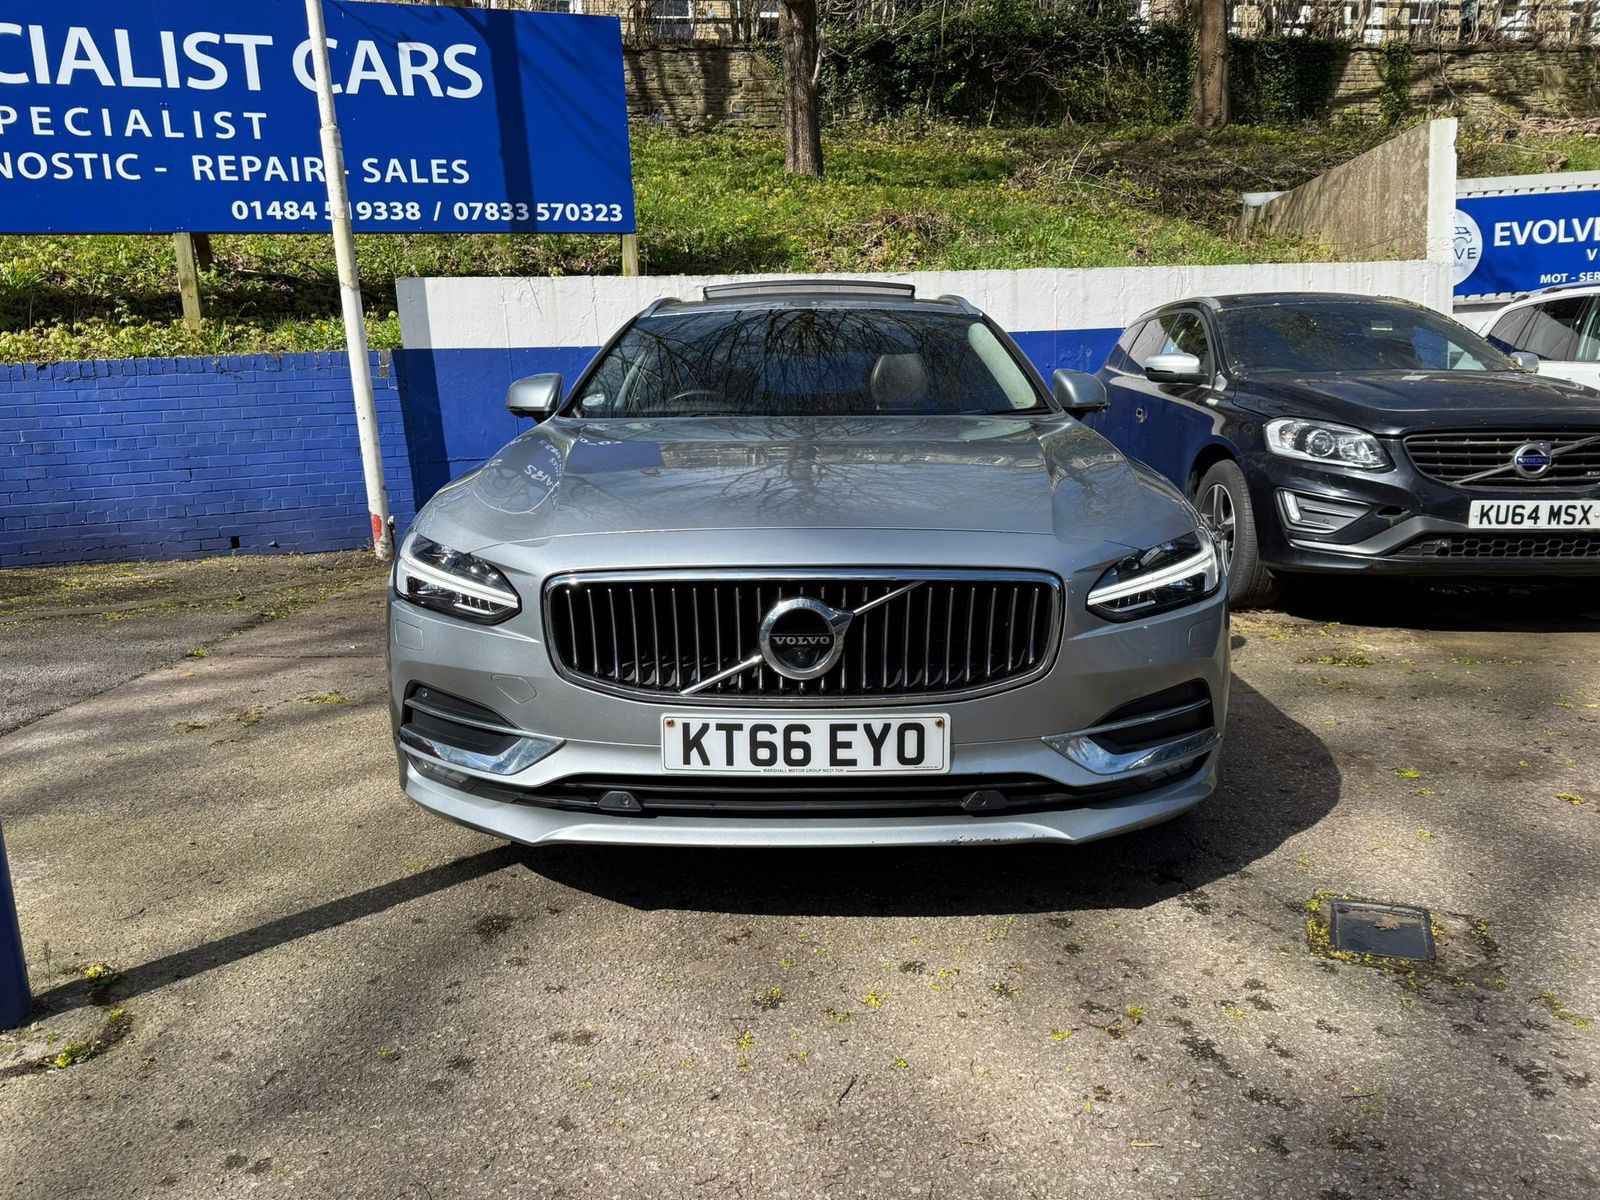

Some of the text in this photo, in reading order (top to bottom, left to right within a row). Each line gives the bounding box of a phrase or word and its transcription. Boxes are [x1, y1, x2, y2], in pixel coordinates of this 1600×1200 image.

[292, 36, 484, 99] CARS
[0, 105, 268, 140] PECIALIST
[191, 154, 326, 182] REPAIR
[361, 158, 470, 184] SALES
[231, 200, 318, 221] 01484
[324, 201, 421, 221] 9338
[453, 202, 530, 222] 07833
[536, 203, 623, 223] 570323
[1540, 273, 1569, 284] MOT
[1478, 504, 1594, 526] KU64 MSX
[772, 635, 831, 645] VOLVO
[682, 722, 925, 767] KT66 EYO
